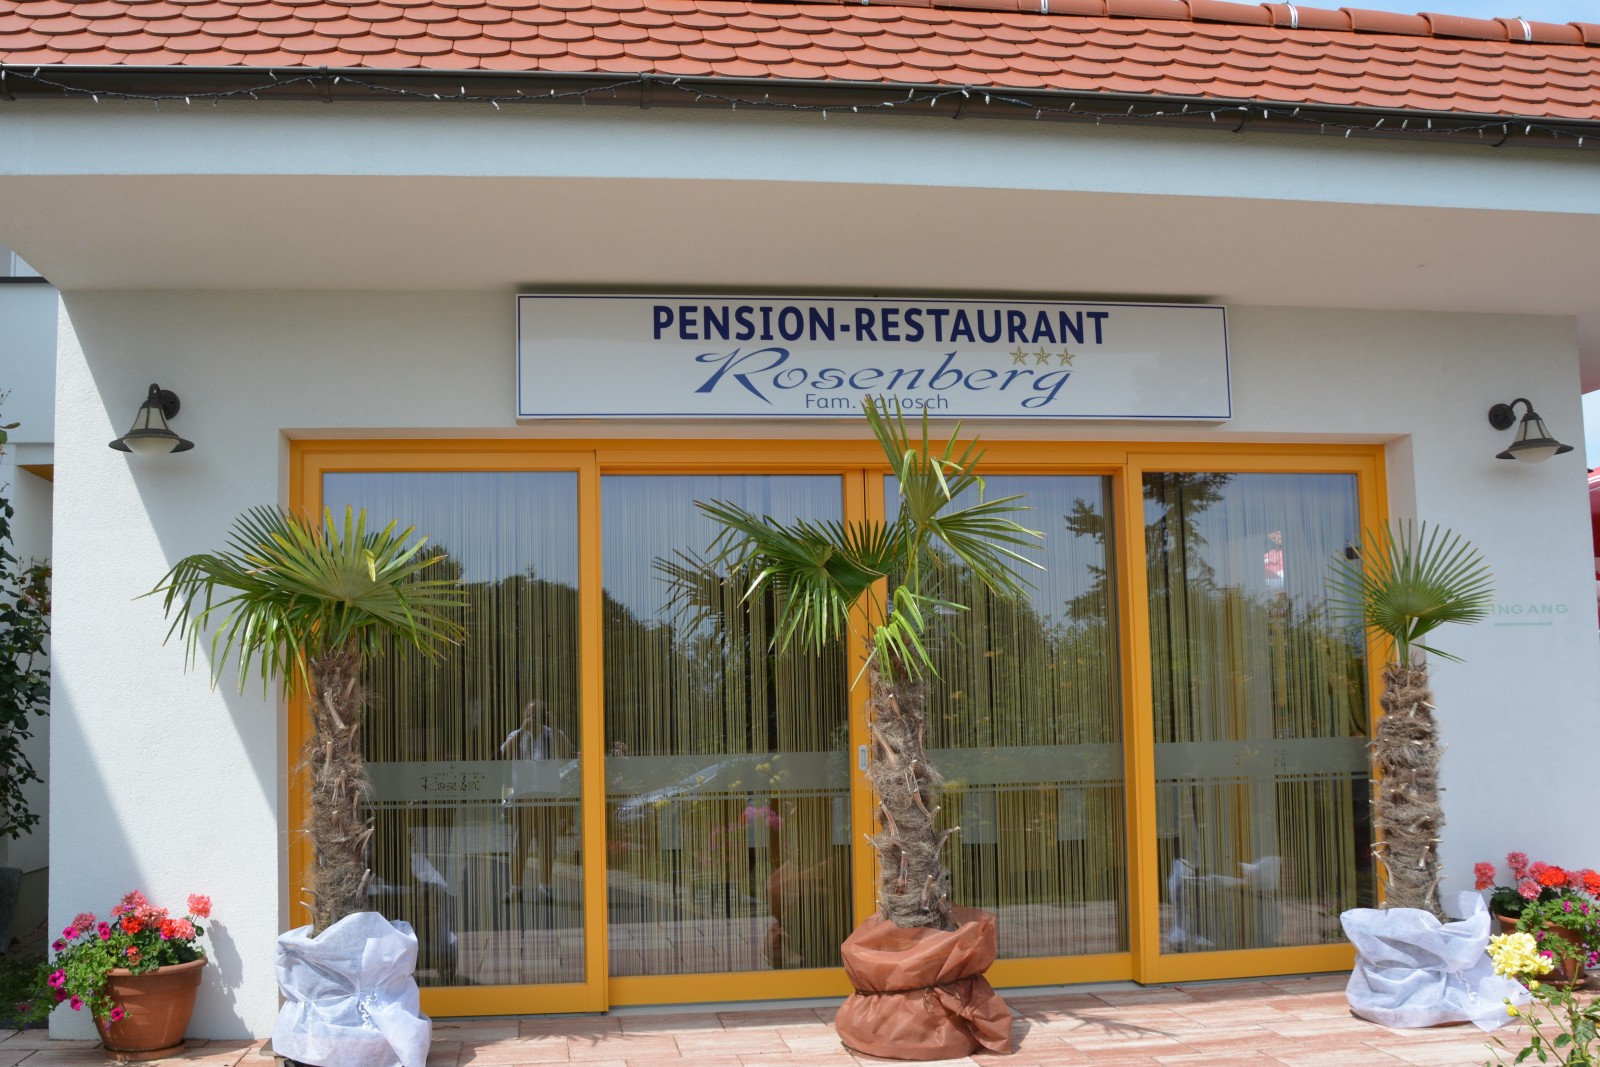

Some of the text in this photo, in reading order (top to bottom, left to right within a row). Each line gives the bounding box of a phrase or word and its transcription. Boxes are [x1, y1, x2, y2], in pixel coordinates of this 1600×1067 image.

[653, 305, 1109, 344] PENSION-RESTAURANT
[694, 347, 1076, 409] Rosenberg
[805, 394, 948, 409] Fam. anosch
